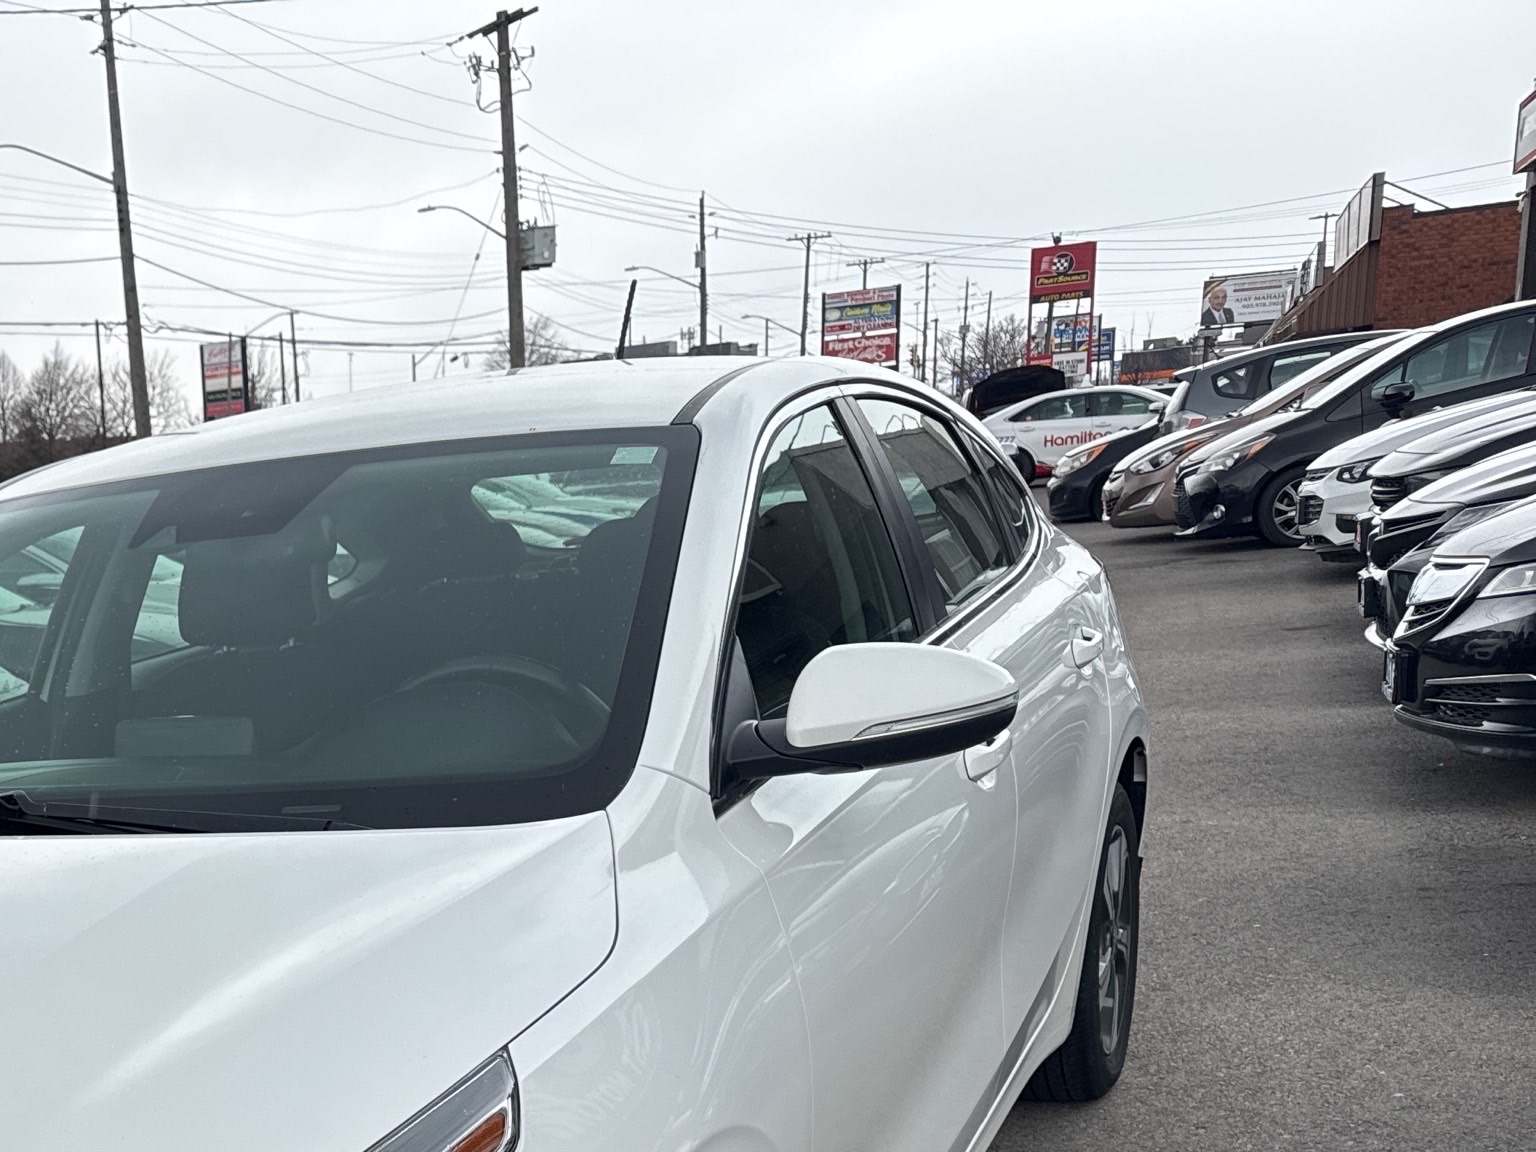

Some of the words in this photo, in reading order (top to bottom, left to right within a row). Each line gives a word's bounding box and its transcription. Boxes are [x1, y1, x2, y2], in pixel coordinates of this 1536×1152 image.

[1040, 293, 1060, 302] AUTO
[1061, 290, 1084, 300] PARTS
[828, 340, 854, 351] First
[855, 336, 891, 348] Choice
